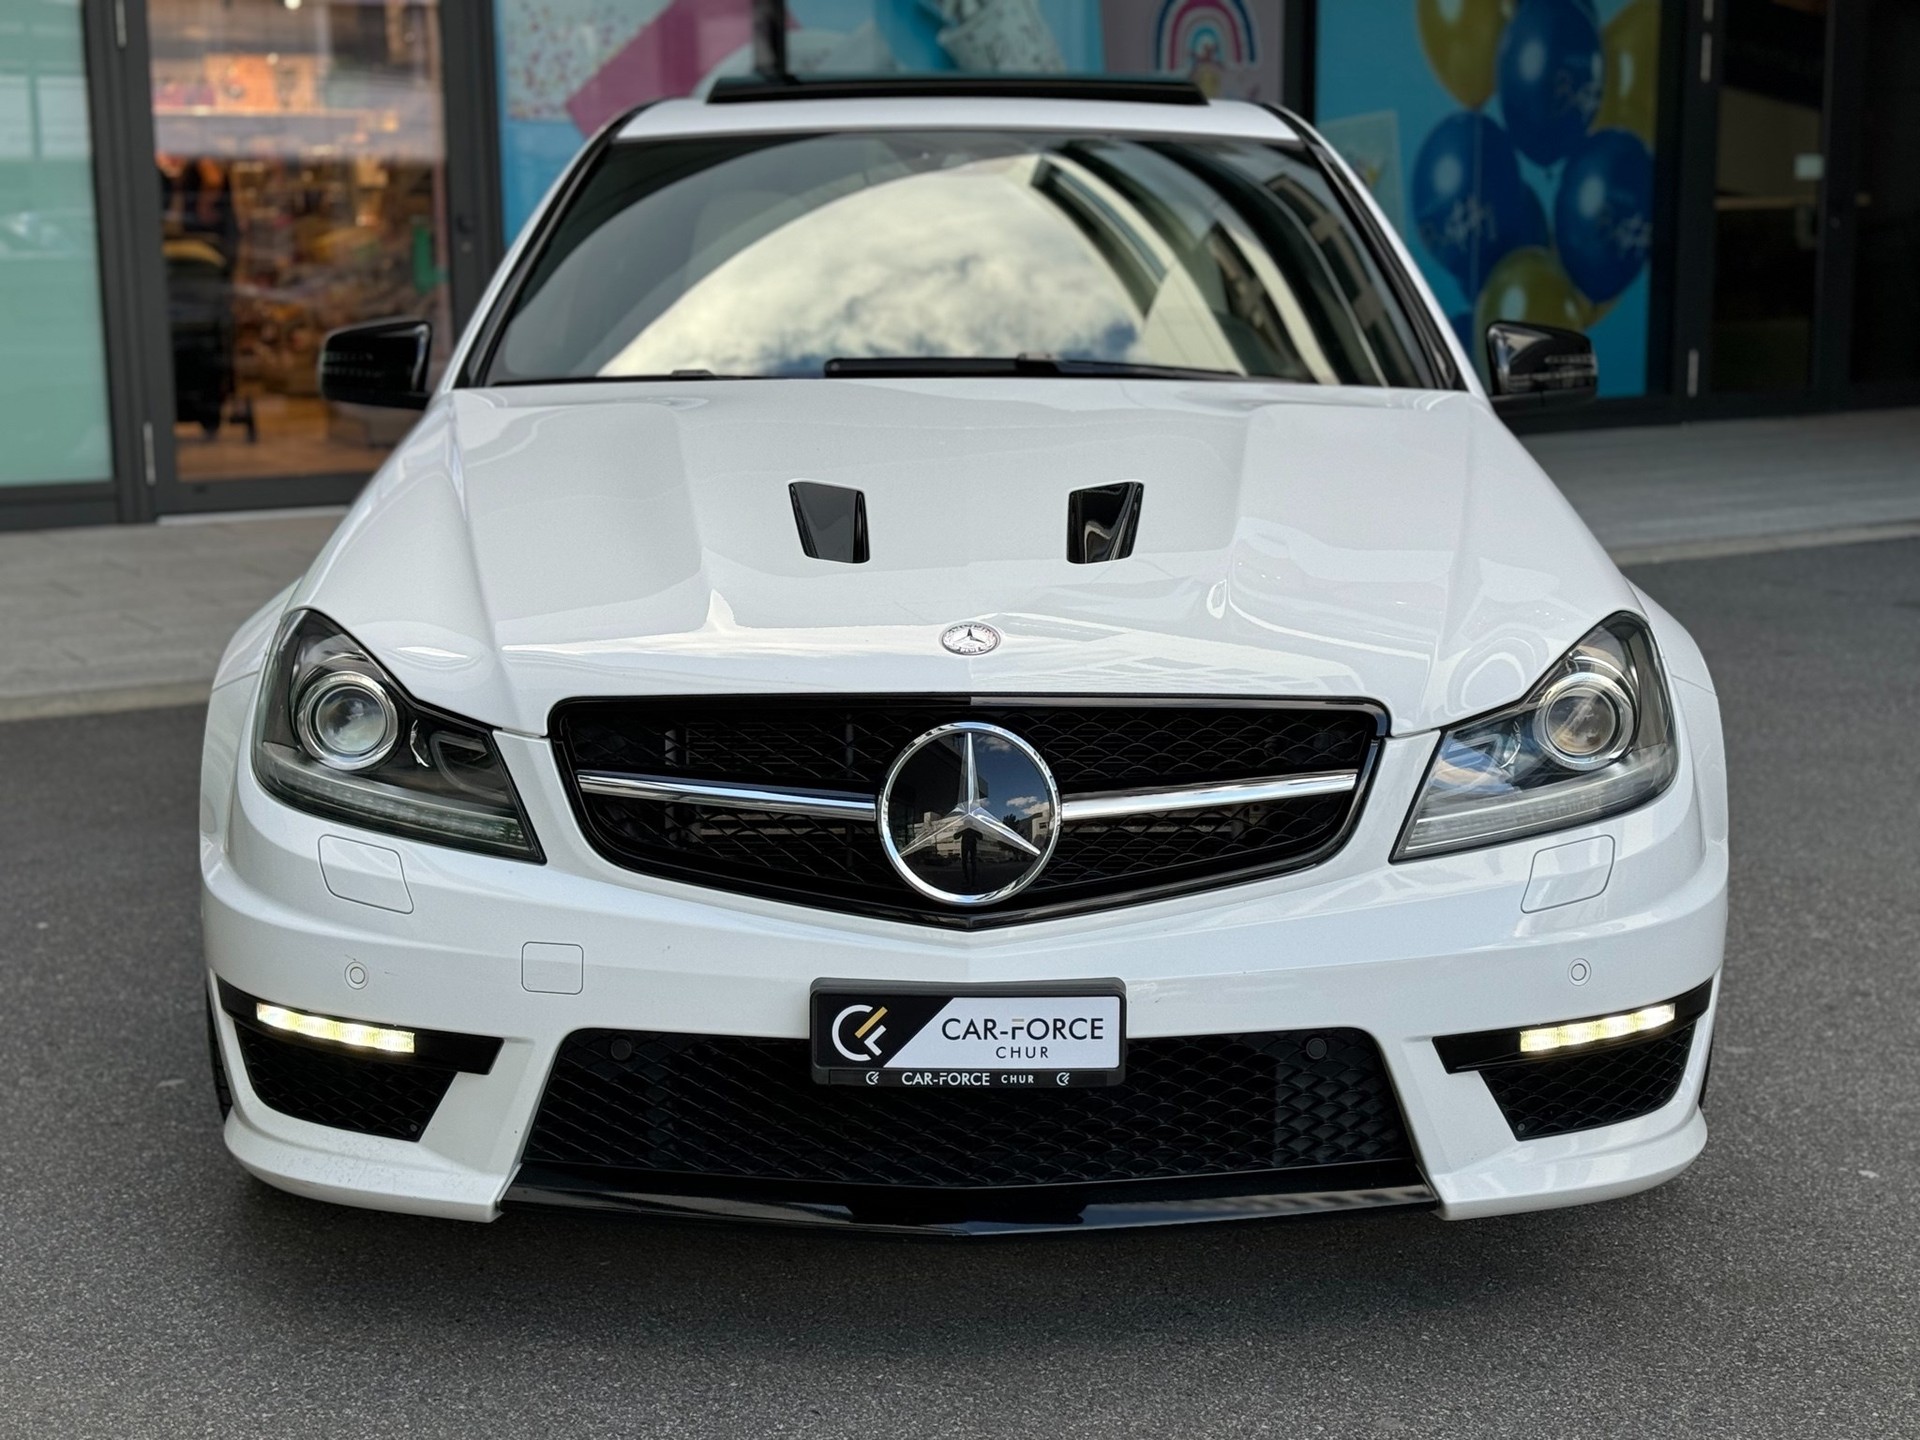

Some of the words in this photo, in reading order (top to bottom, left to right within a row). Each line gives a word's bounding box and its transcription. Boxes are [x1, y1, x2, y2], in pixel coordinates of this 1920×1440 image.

[941, 1017, 1104, 1041] CAR-FORCE
[995, 1046, 1049, 1059] CHUR
[901, 1071, 990, 1086] CAR-FORCE
[1000, 1073, 1035, 1084] CHUR
